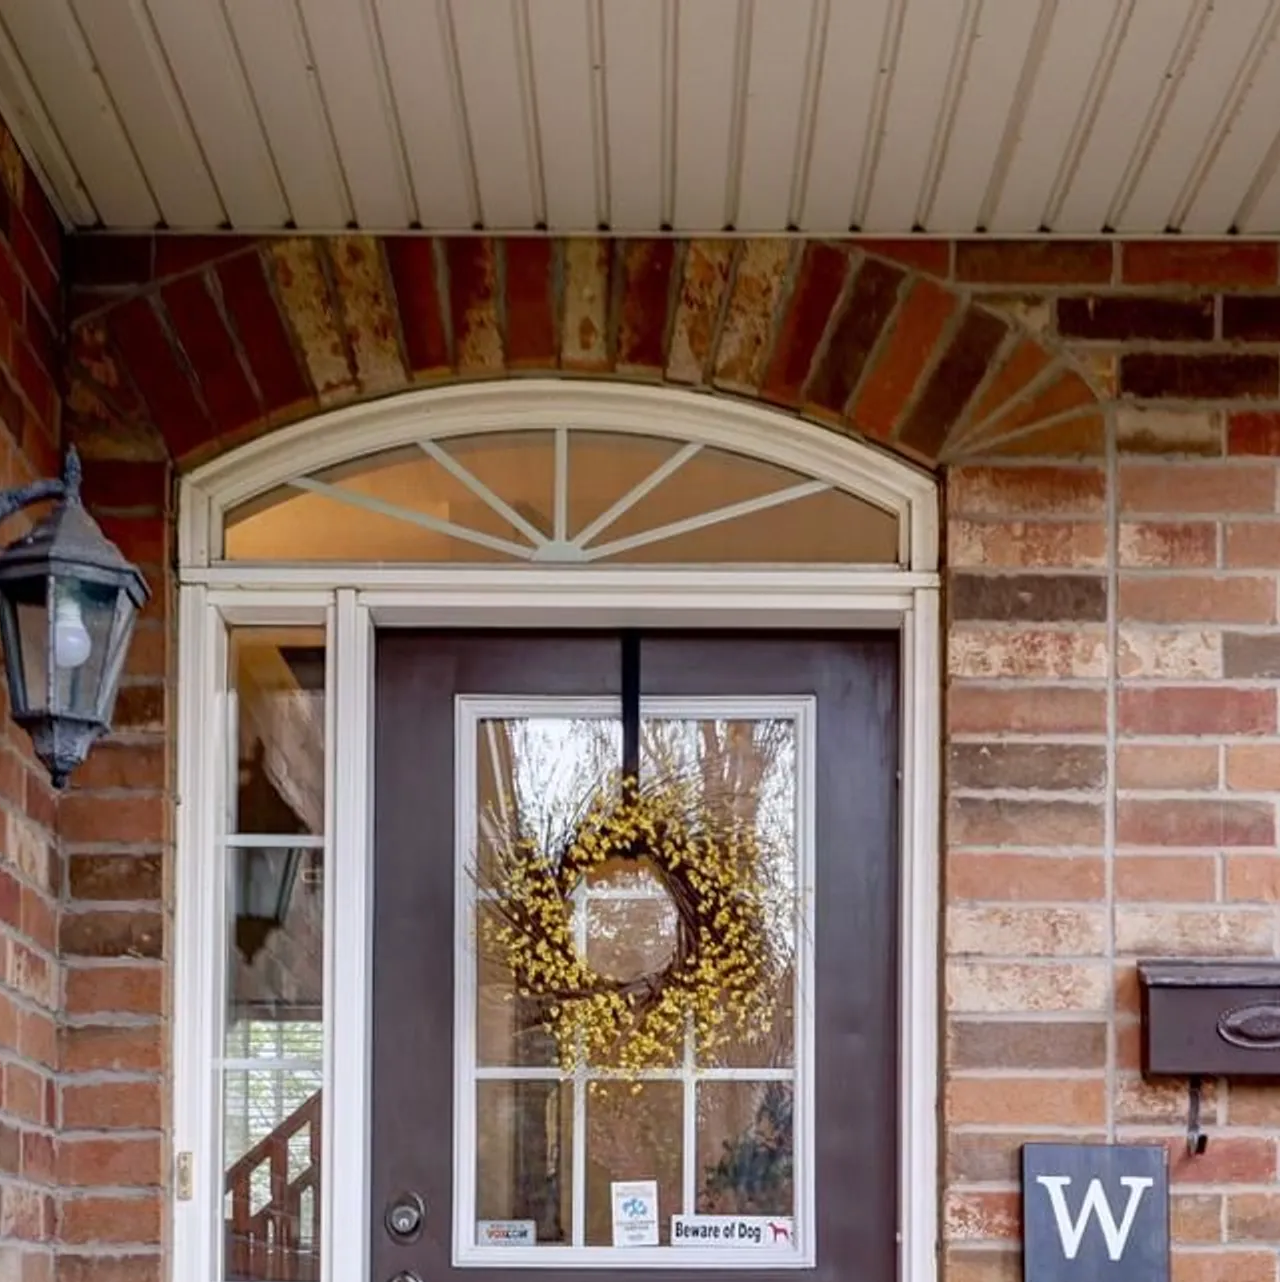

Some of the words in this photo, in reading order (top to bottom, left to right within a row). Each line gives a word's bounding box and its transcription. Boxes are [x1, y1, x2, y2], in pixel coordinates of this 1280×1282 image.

[675, 1222, 720, 1239] Beware
[723, 1222, 736, 1239] of
[738, 1222, 762, 1243] Dog
